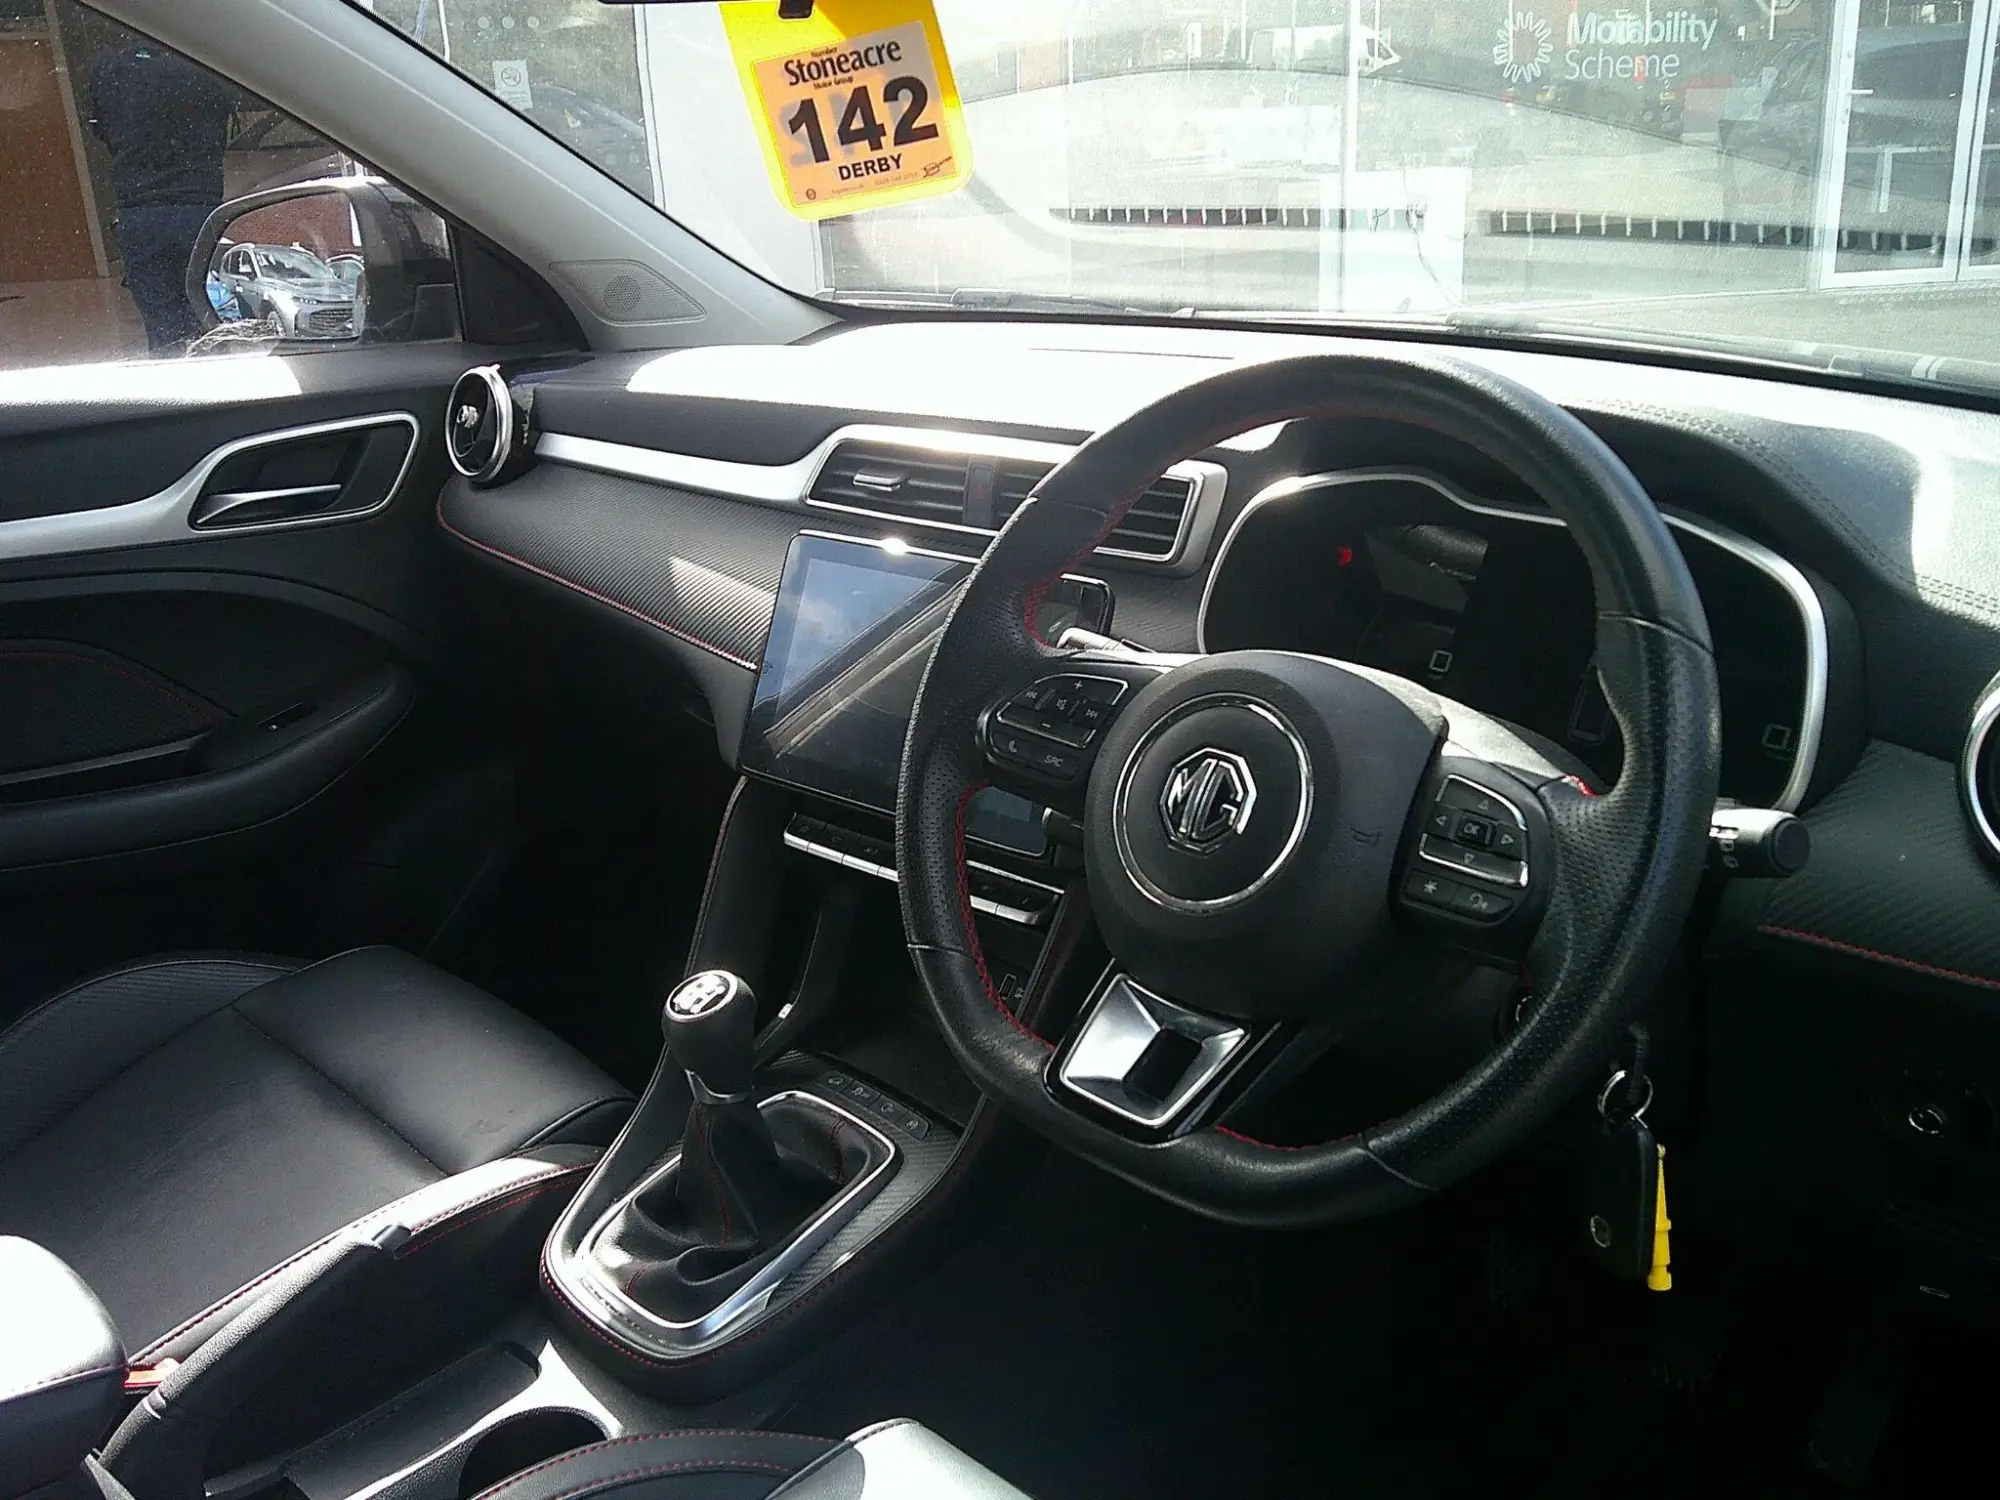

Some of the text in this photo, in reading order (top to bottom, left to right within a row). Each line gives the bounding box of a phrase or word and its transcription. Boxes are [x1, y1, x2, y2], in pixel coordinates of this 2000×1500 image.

[1566, 9, 1718, 51] Motability
[784, 41, 902, 86] Stoneacre
[1563, 48, 1680, 81] Scheme
[788, 76, 939, 163] 142
[838, 153, 903, 180] DERBY
[1166, 757, 1245, 839] MG
